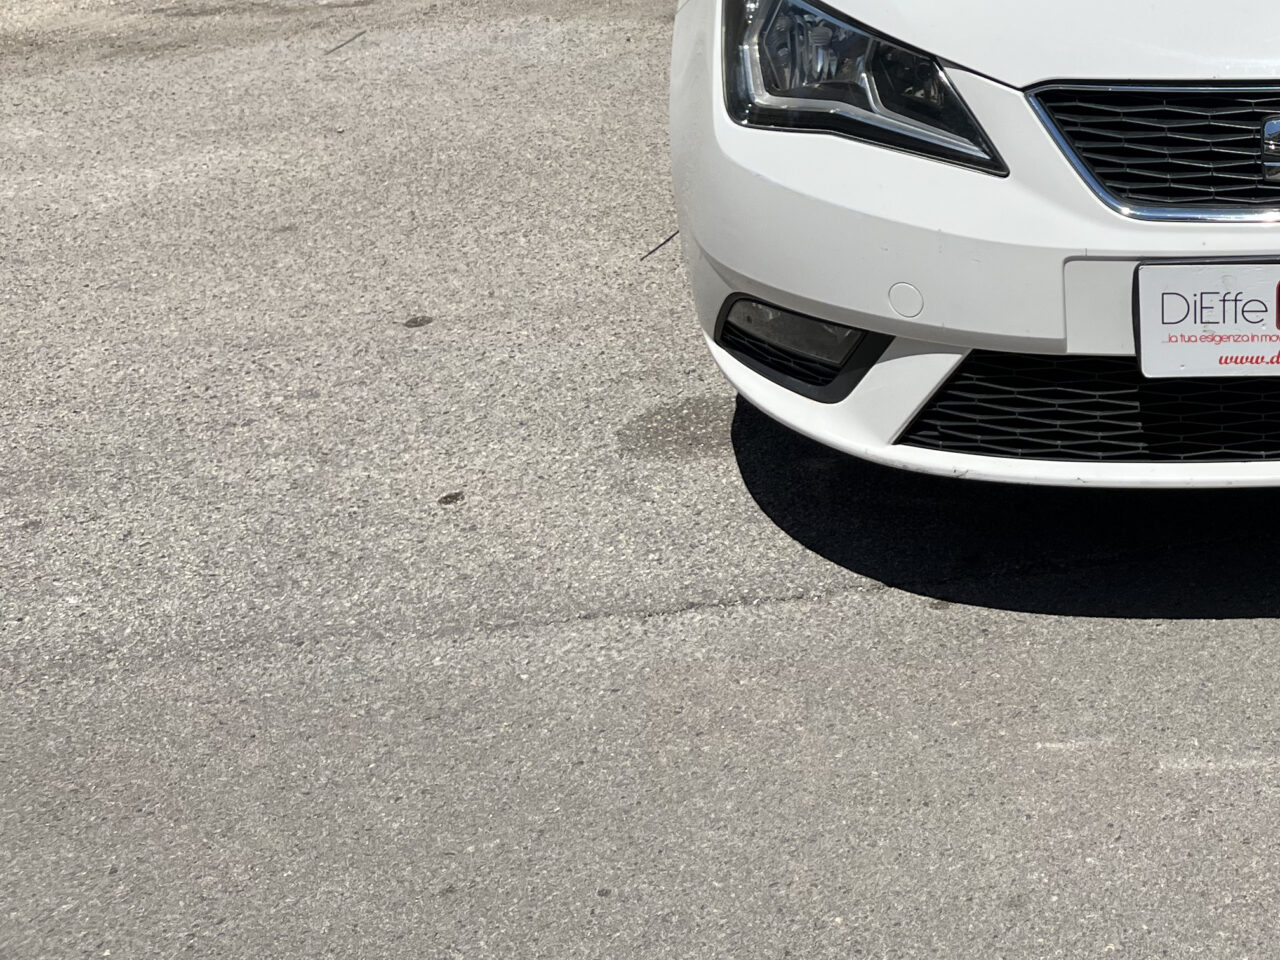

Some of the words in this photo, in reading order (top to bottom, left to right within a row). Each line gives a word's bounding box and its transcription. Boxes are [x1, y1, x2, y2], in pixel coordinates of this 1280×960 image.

[1161, 291, 1269, 326] DiEffe
[1181, 333, 1198, 344] tua
[1200, 333, 1249, 346] esigenza
